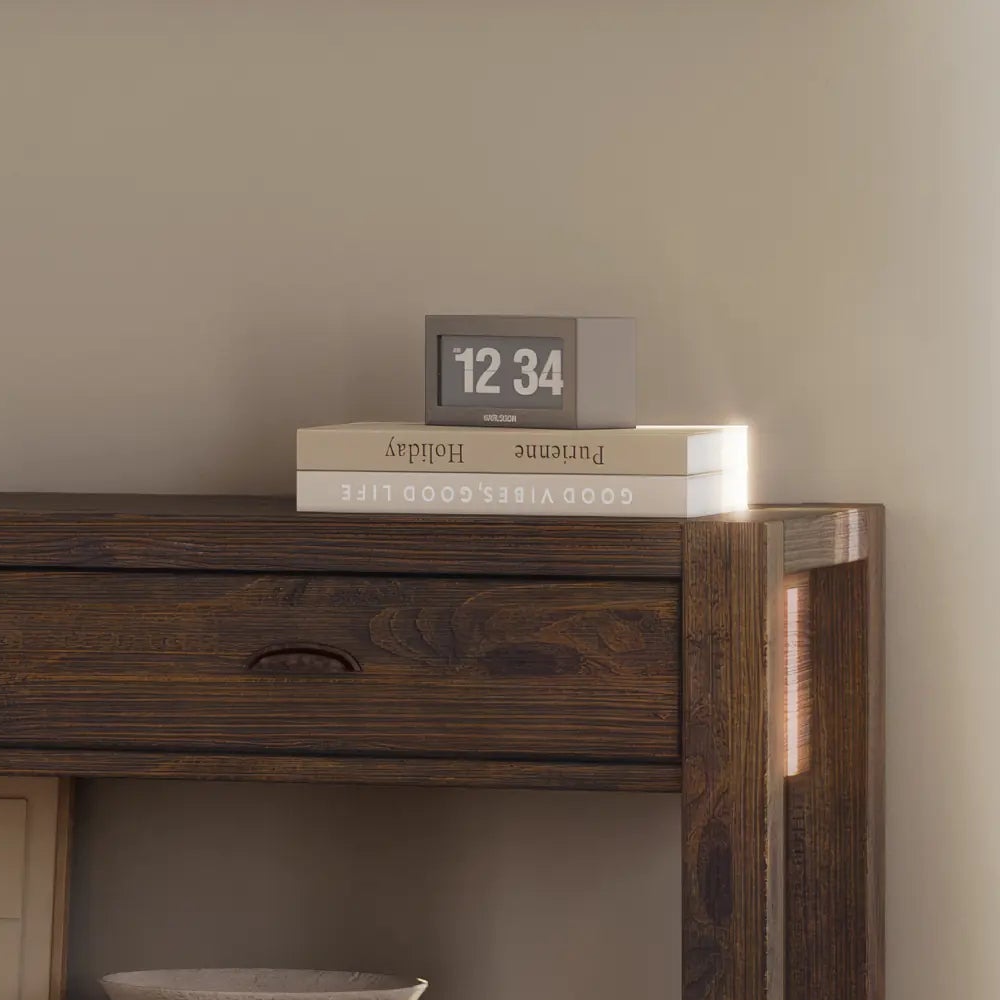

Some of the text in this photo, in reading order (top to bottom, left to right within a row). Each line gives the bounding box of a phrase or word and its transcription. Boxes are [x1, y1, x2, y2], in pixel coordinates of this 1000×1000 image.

[455, 347, 564, 395] 12 34
[385, 437, 605, 465] Purienne Holiday
[341, 484, 393, 502] LIFE
[564, 487, 633, 505] GOOD
